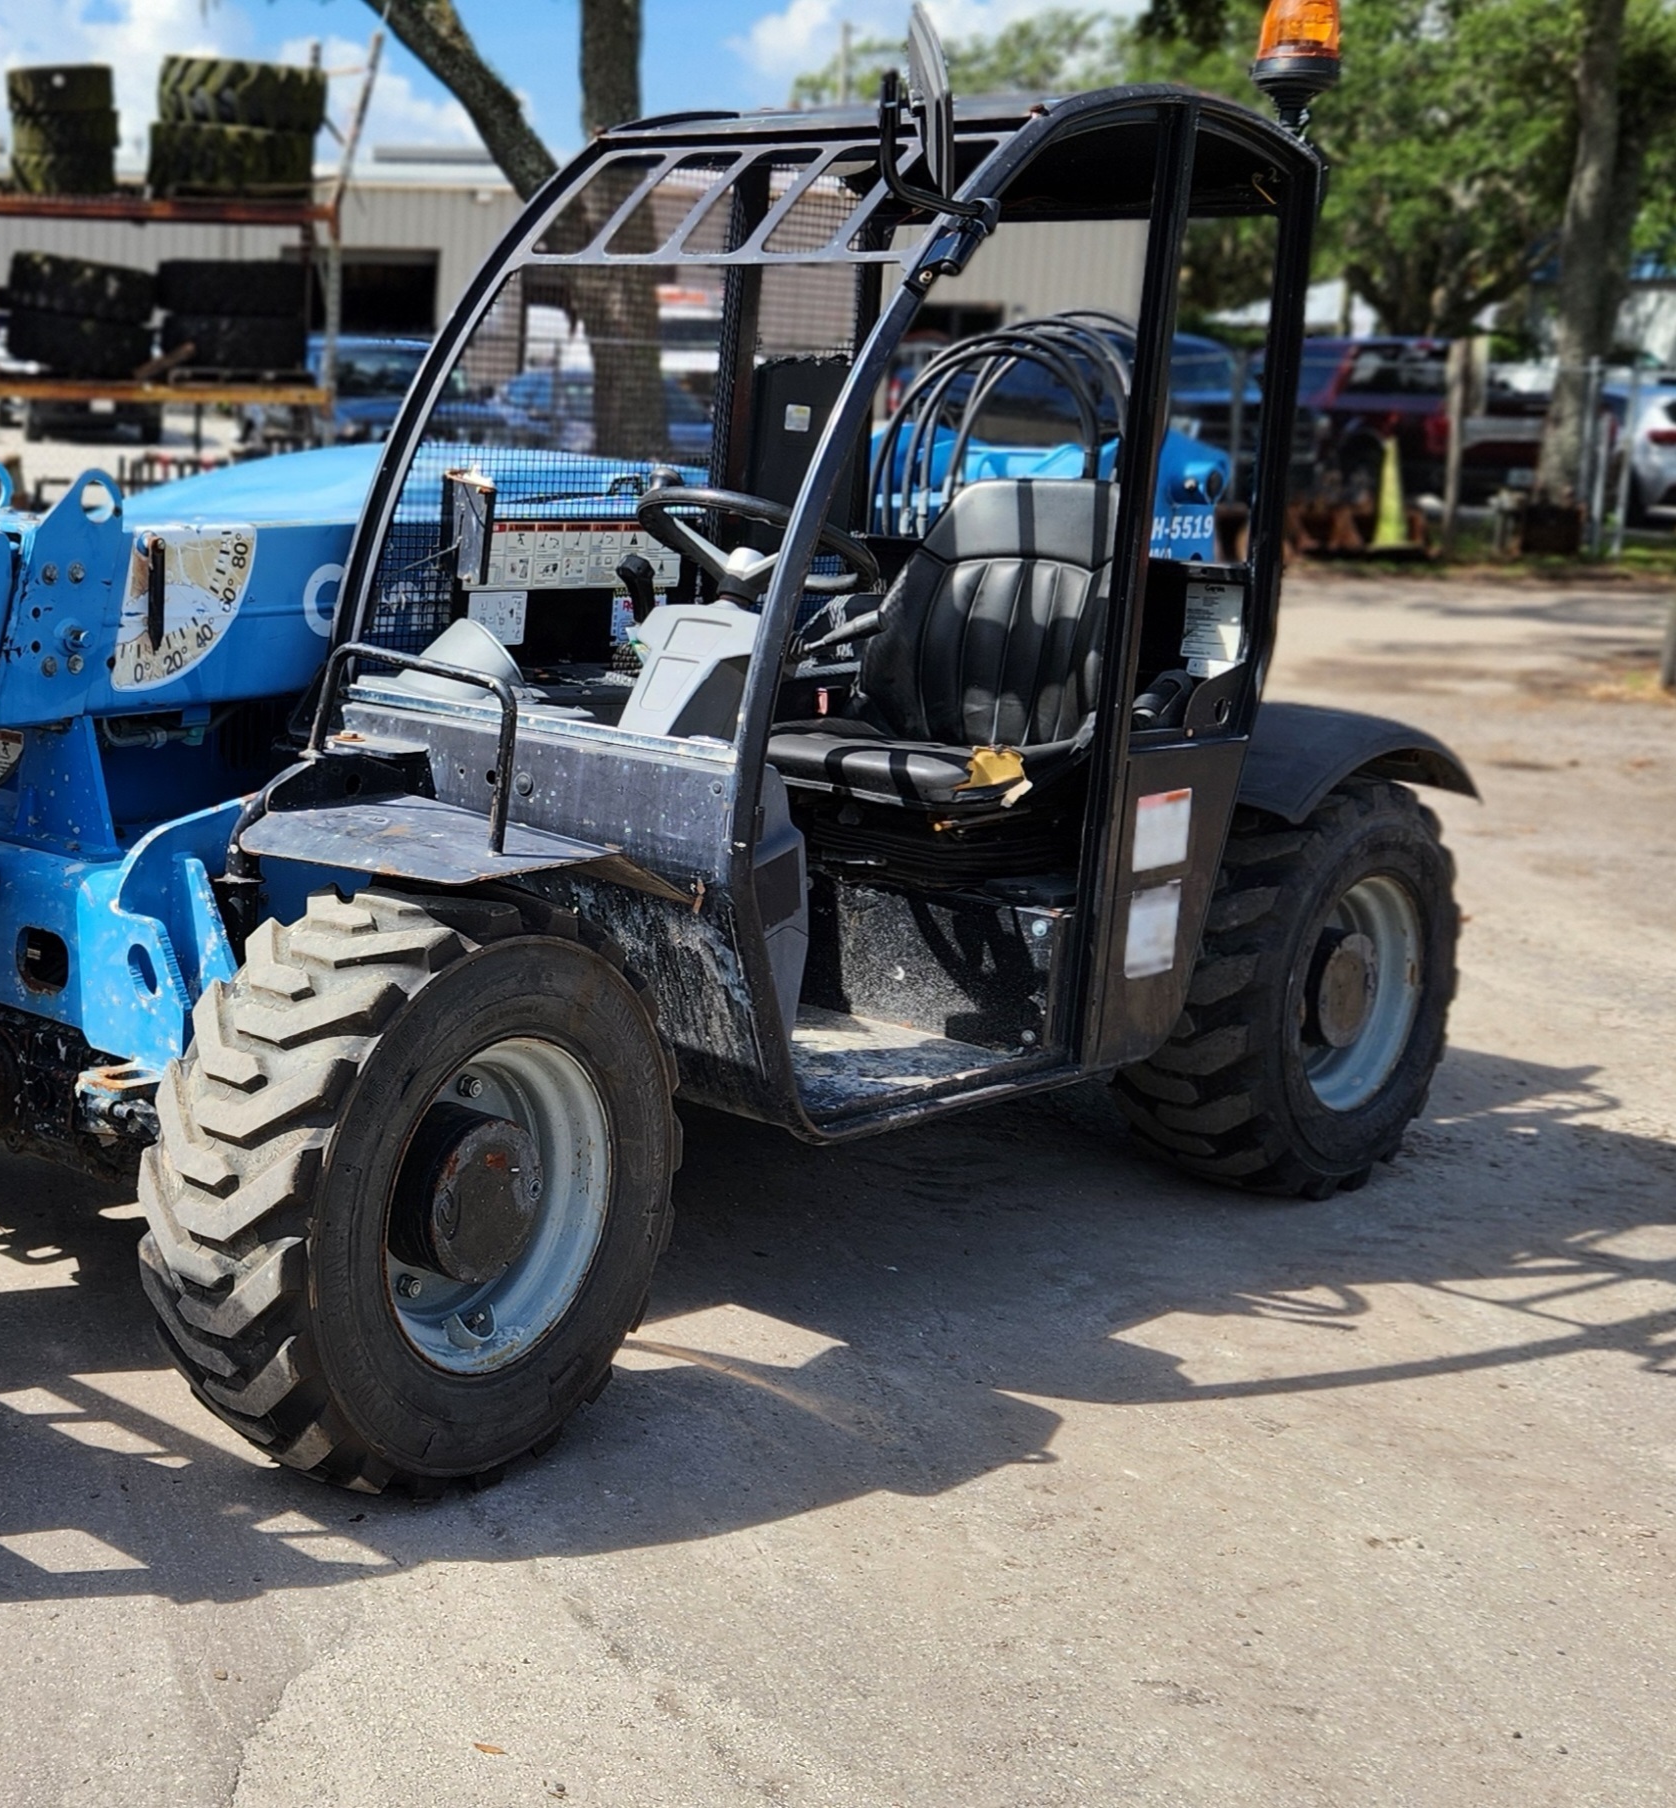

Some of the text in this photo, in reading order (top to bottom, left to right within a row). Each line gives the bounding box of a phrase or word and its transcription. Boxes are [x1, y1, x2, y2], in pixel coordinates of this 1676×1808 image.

[195, 616, 215, 648] 40°
[133, 662, 151, 683] 0°
[163, 646, 188, 675] 20°
